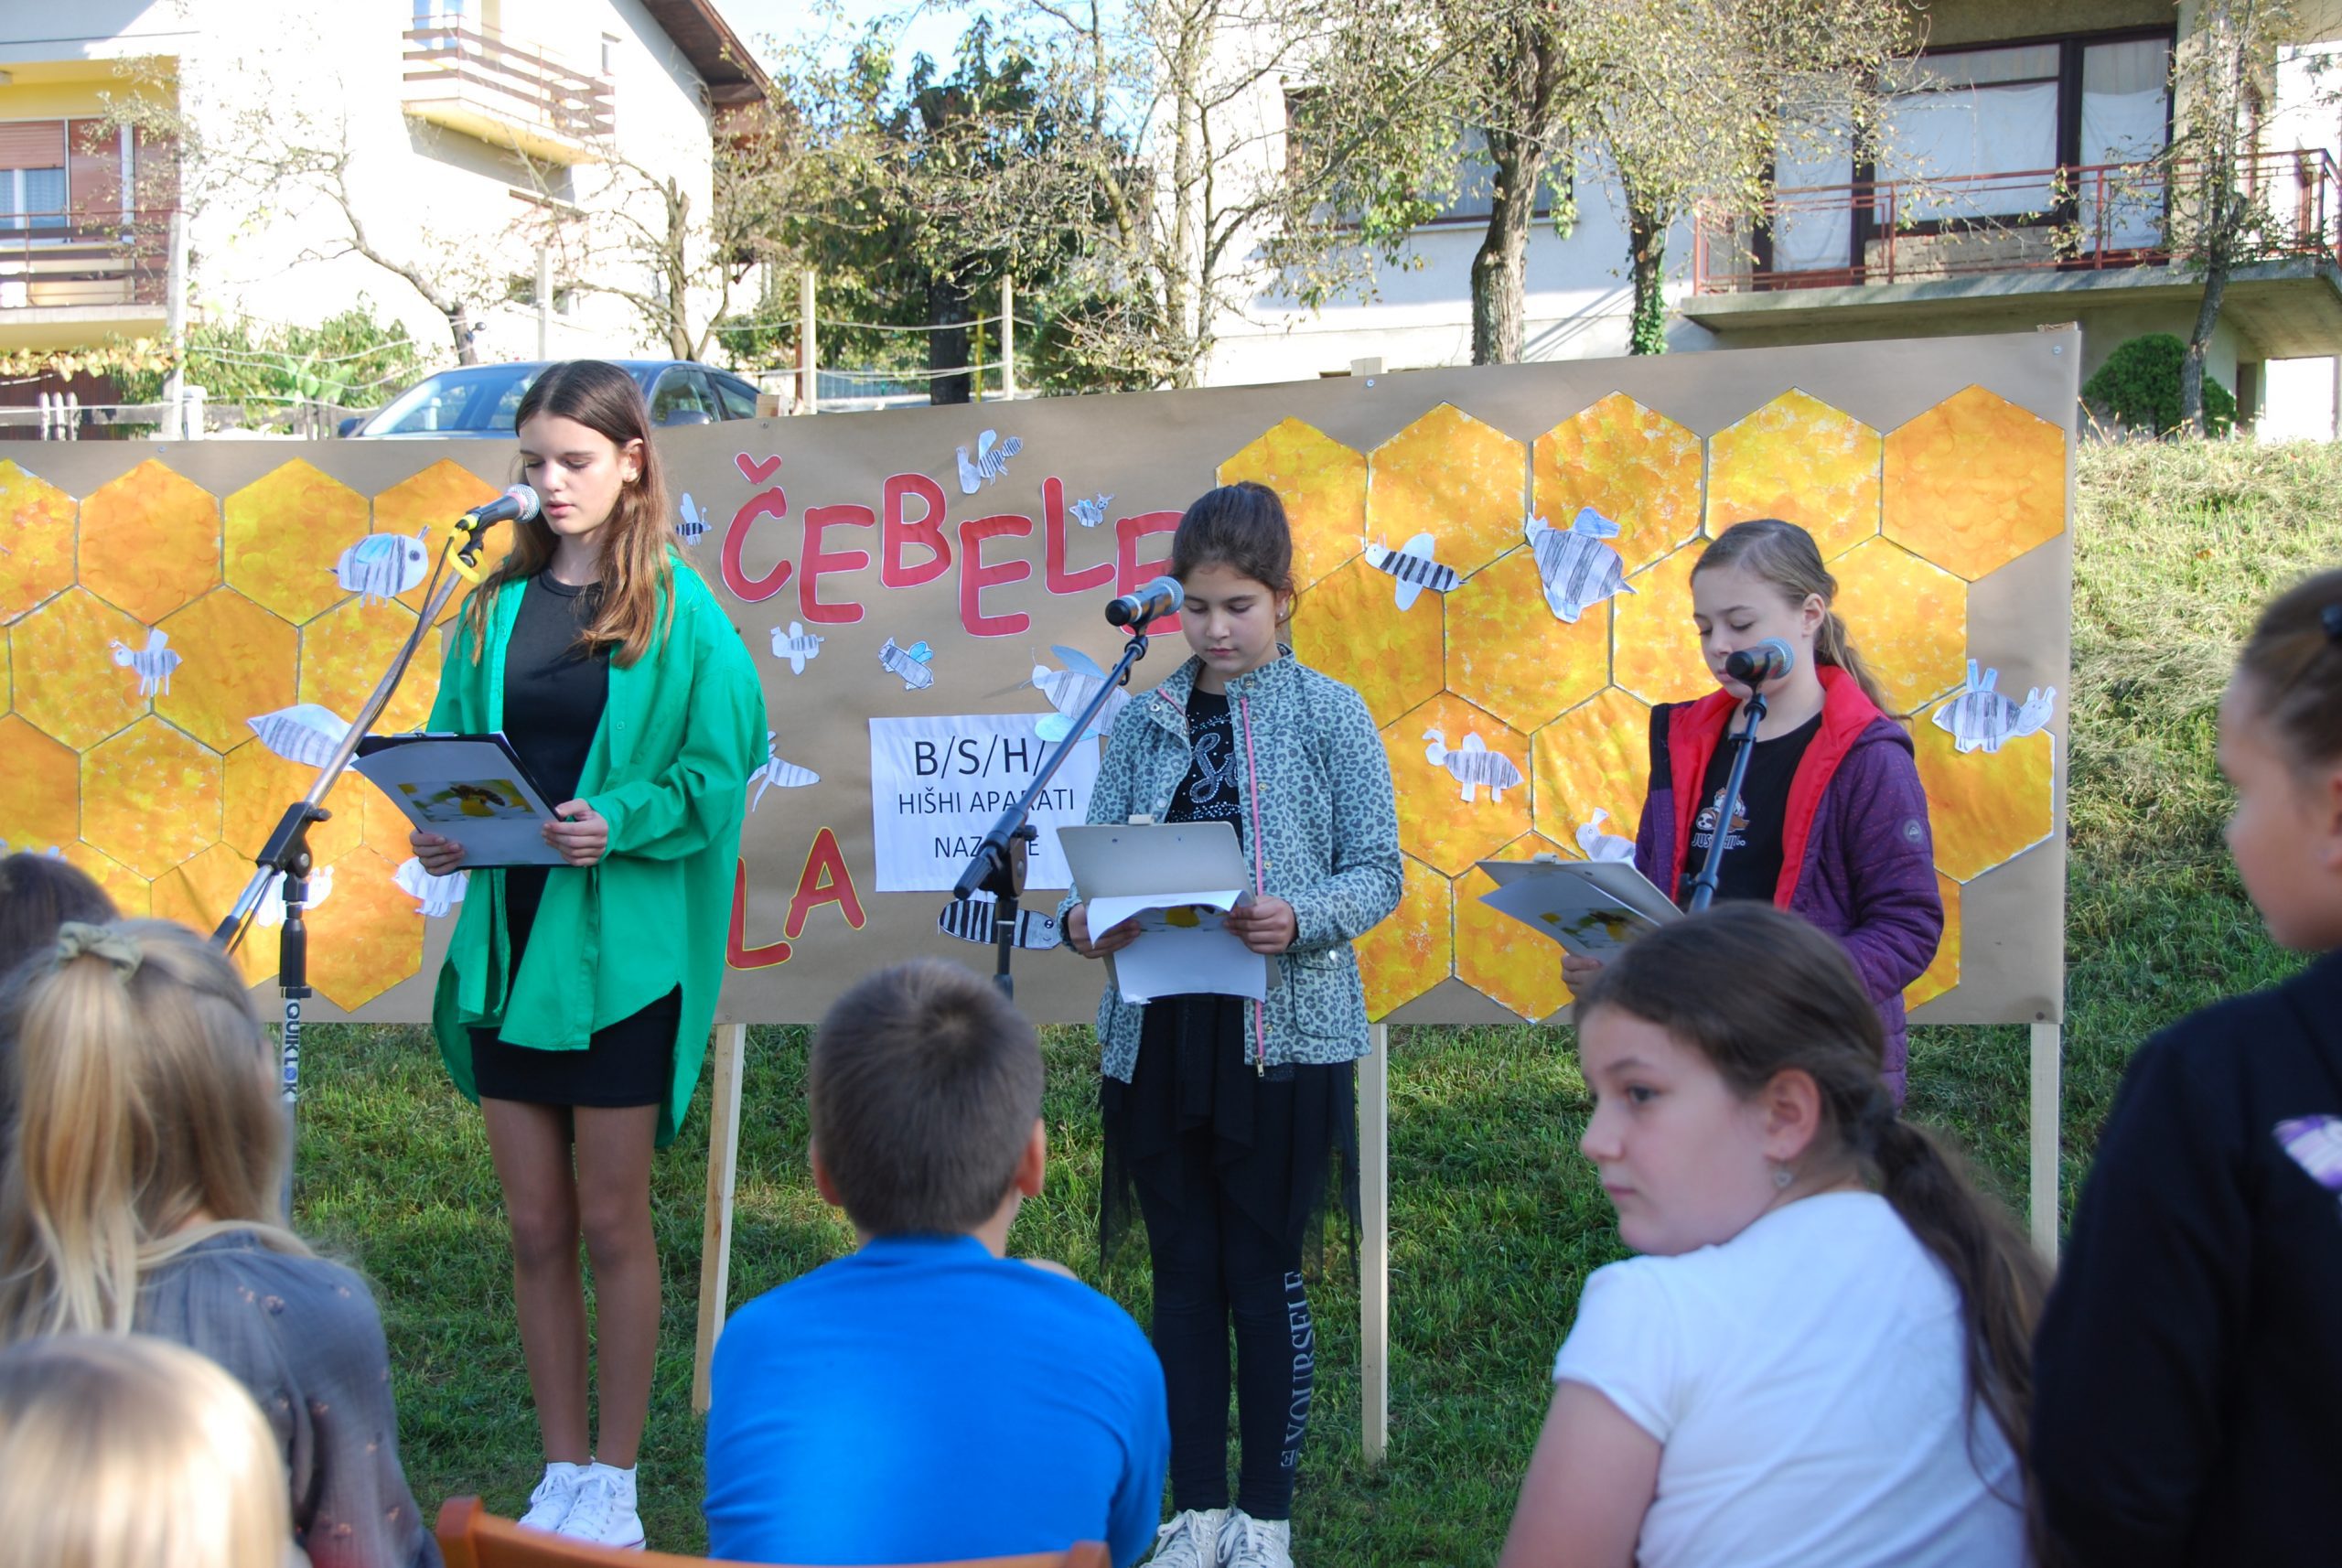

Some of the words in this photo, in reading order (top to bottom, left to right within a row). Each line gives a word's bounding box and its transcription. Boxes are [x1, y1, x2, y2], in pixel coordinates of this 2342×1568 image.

[721, 452, 1186, 638] ČEBELE
[915, 735, 1046, 779] B/S/H/
[898, 787, 961, 814] HIŠHI
[285, 1002, 300, 1053] QUIK
